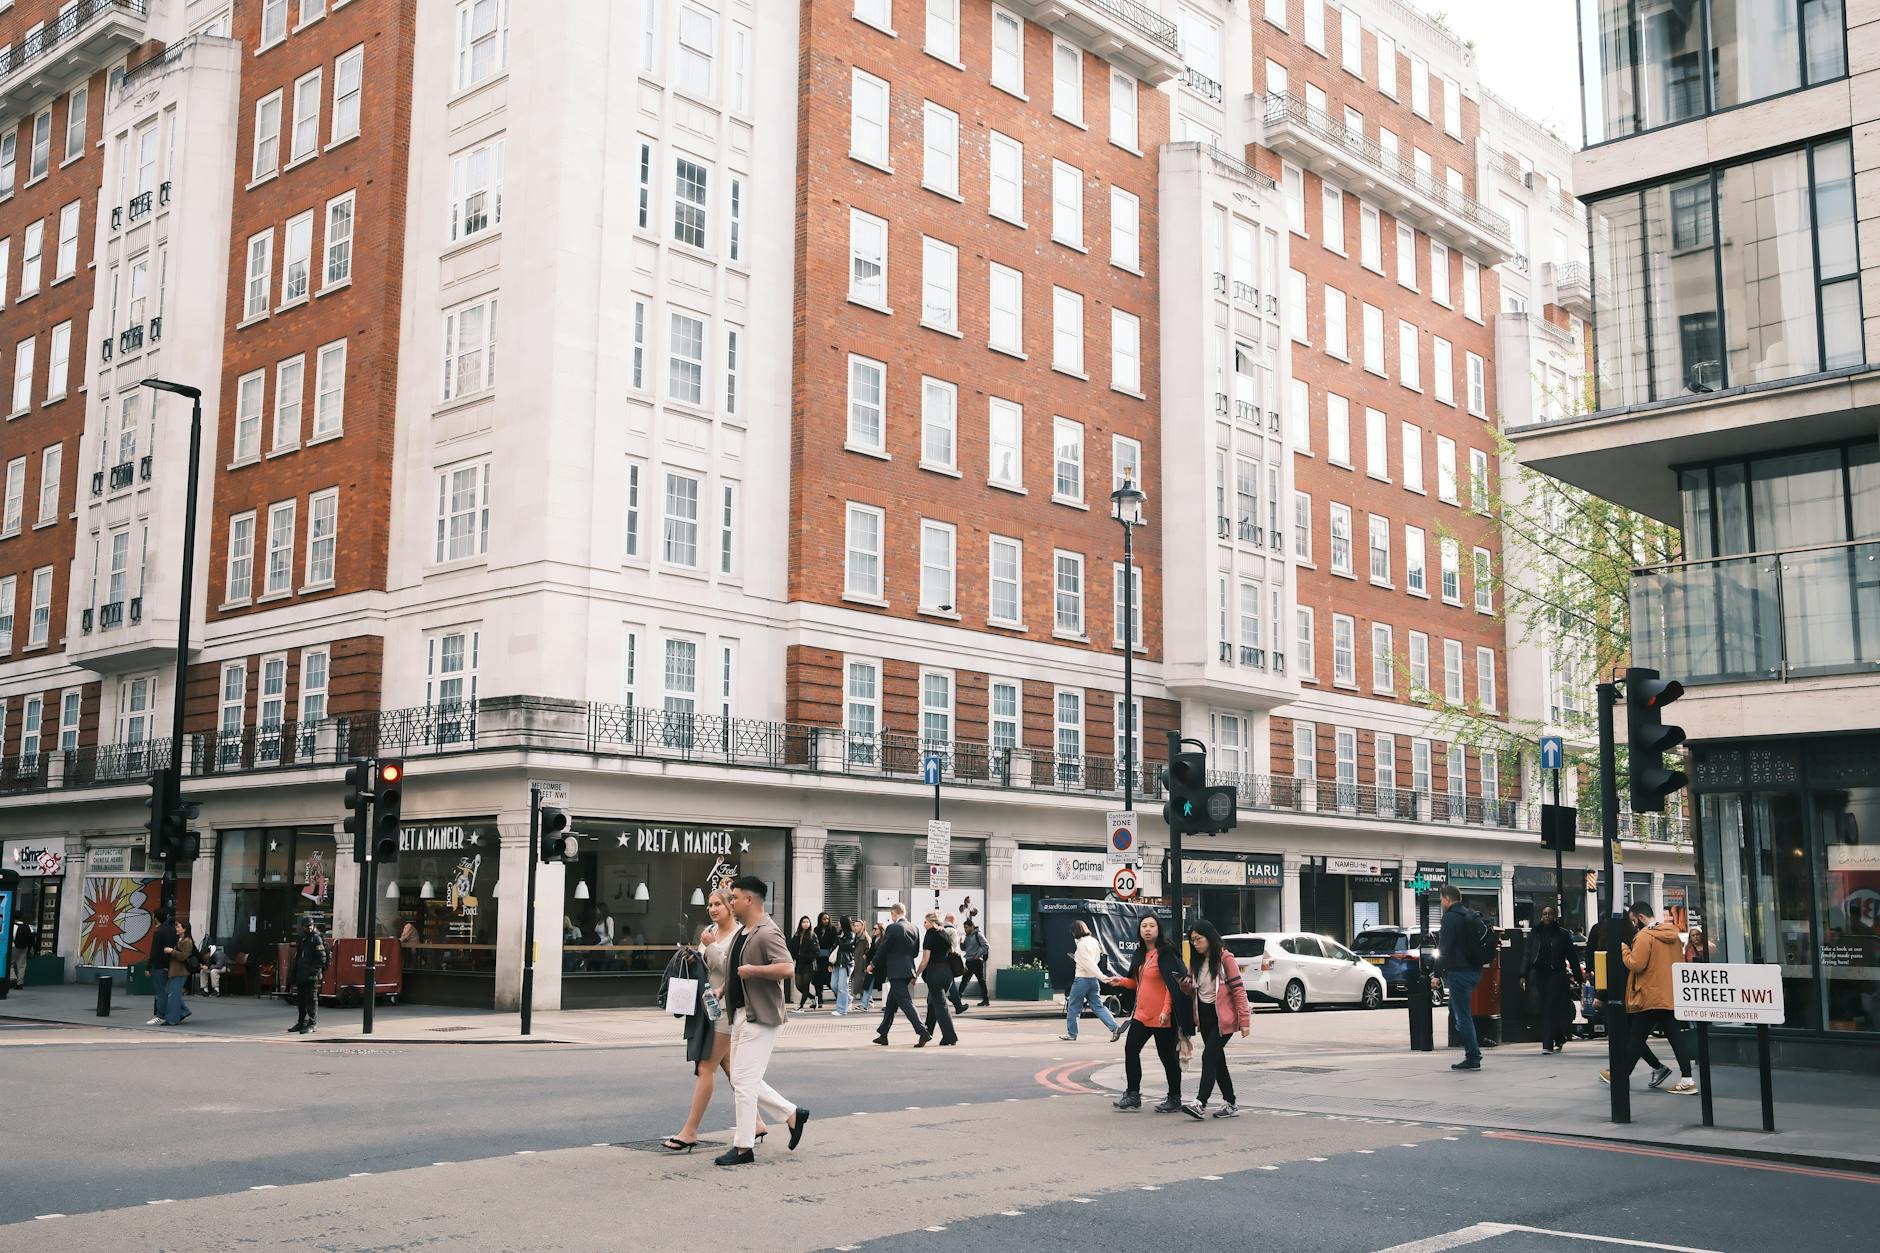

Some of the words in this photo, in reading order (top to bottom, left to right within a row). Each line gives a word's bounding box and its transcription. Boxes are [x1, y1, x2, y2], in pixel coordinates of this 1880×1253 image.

[532, 782, 562, 791] MELCOMBE
[400, 828, 416, 851] RET
[417, 828, 424, 851] A
[427, 826, 464, 850] MANGER
[637, 828, 668, 853] PRET
[671, 830, 680, 853] A
[684, 830, 732, 855] MANGER
[1073, 859, 1105, 872] Optimal
[1184, 861, 1196, 874] La
[1247, 864, 1279, 877] HARU
[1117, 877, 1135, 890] 20
[99, 914, 110, 924] 209
[1681, 969, 1729, 984] BAKER
[1683, 987, 1736, 1002] STREET
[1741, 989, 1773, 1004] NW1
[1700, 1010, 1708, 1018] OF
[1710, 1011, 1759, 1020] WESTMINSTER
